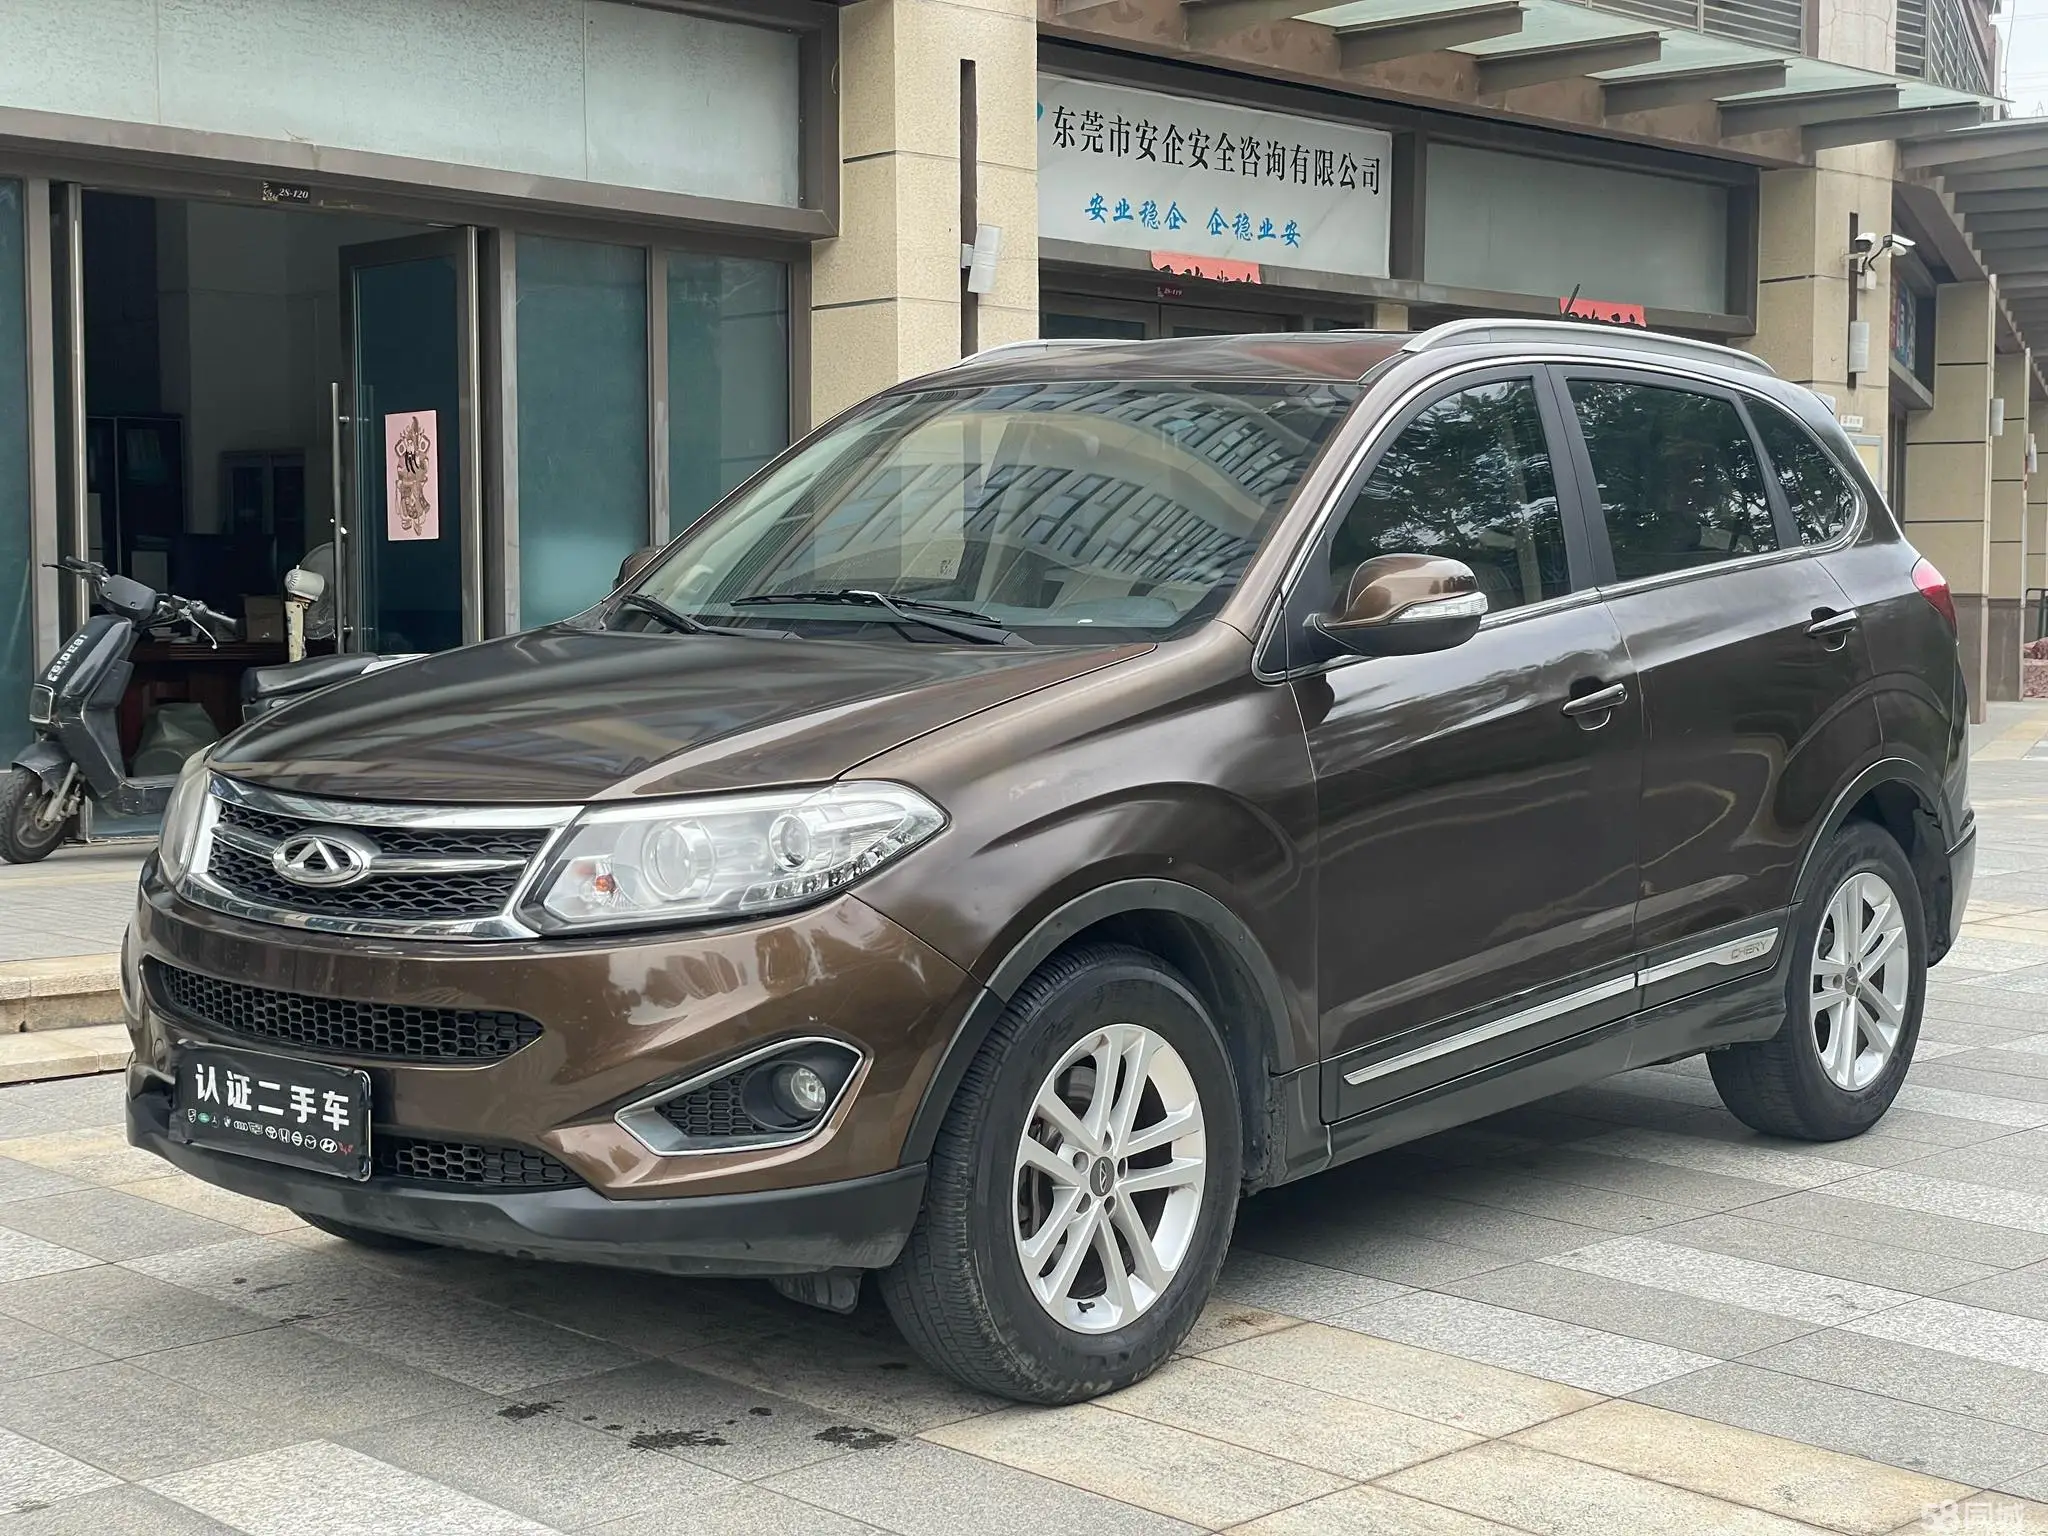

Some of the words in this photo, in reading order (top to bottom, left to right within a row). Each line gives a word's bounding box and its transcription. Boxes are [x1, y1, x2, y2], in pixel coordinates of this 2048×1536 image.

[1052, 105, 1381, 195] 东莞市安企安全咨询有限公司
[1084, 193, 1188, 231] 安业稳企
[1206, 207, 1302, 249] 企稳业安
[1731, 940, 1769, 960] CHERY
[195, 1063, 350, 1132] 认证二手车
